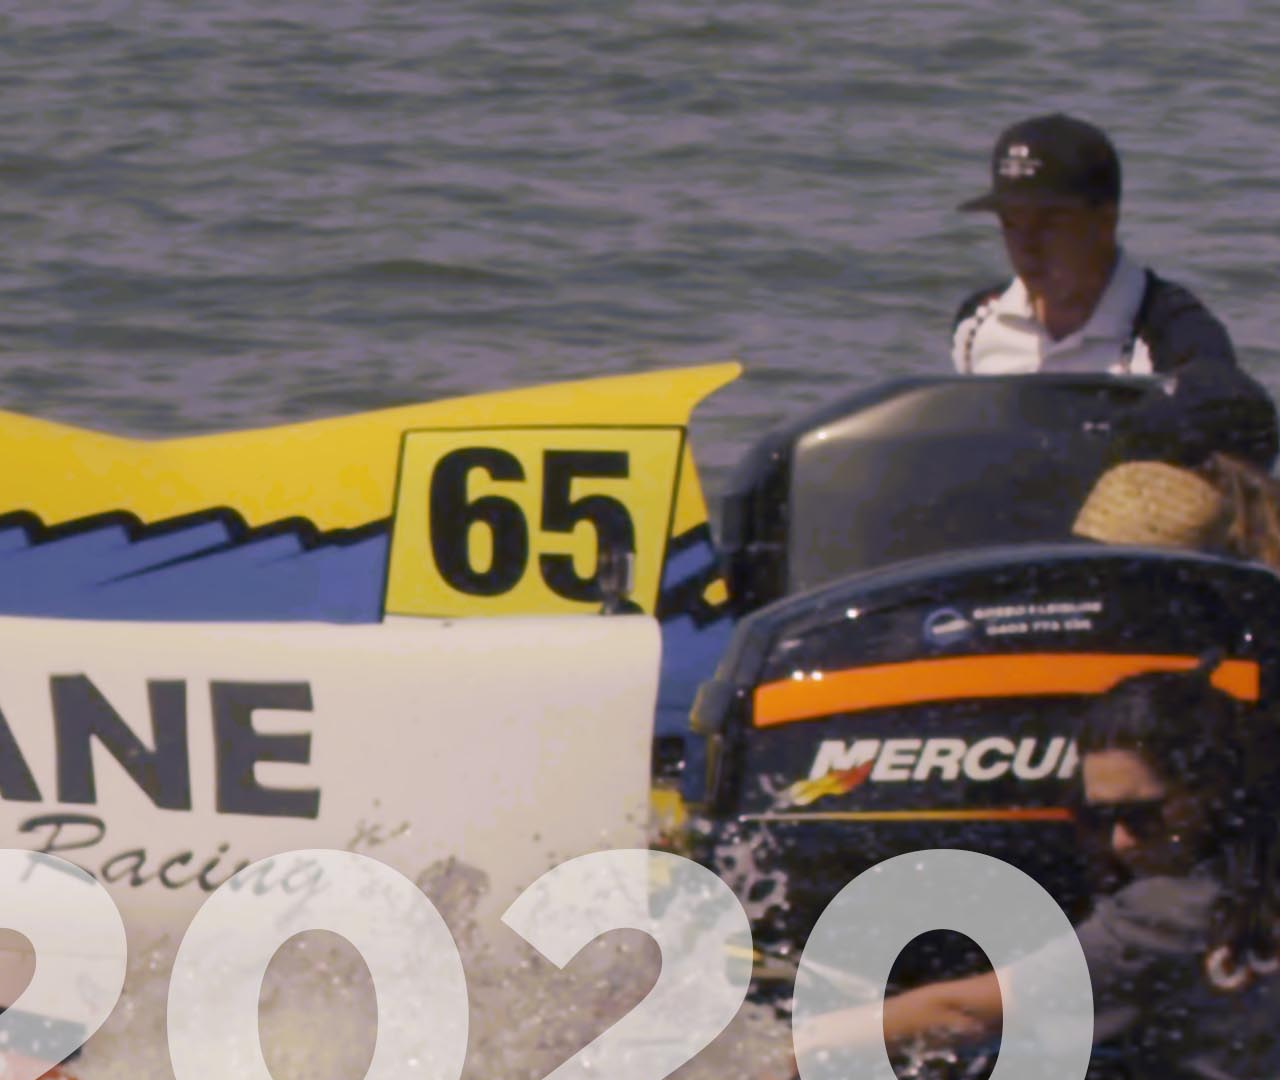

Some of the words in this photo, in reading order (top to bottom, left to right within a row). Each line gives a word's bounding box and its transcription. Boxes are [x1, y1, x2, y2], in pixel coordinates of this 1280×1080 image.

[428, 446, 636, 602] 65
[809, 736, 1079, 780] MERCU
[18, 812, 328, 930] Racing
